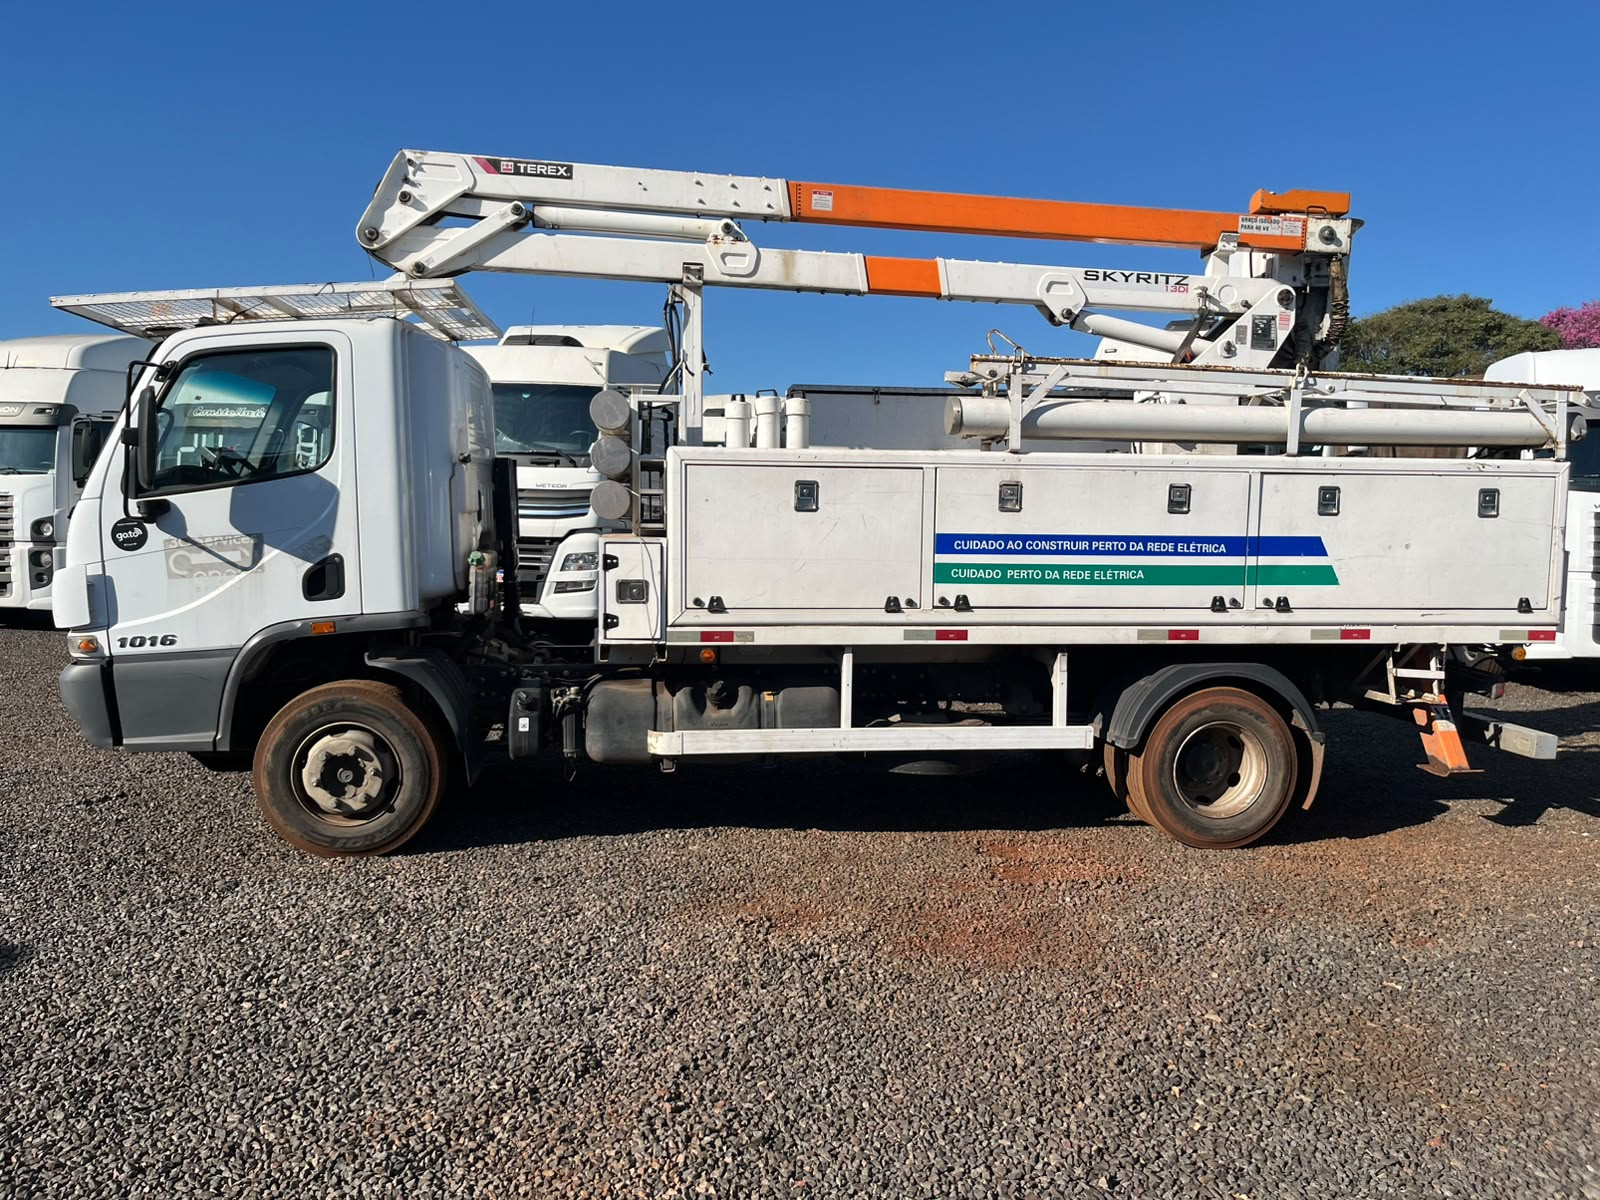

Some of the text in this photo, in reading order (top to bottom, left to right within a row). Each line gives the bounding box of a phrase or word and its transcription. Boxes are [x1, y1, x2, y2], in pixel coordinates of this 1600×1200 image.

[517, 163, 568, 176] TEREX
[1084, 270, 1190, 286] SKYRITZ
[954, 540, 1226, 553] CUIDADO AO CONSTRUIR PERTO DA REDE ELÉTRICA
[951, 569, 1144, 580] CUIDADO PERTO DA REDE ELÉTRICA
[117, 634, 178, 648] 1016
